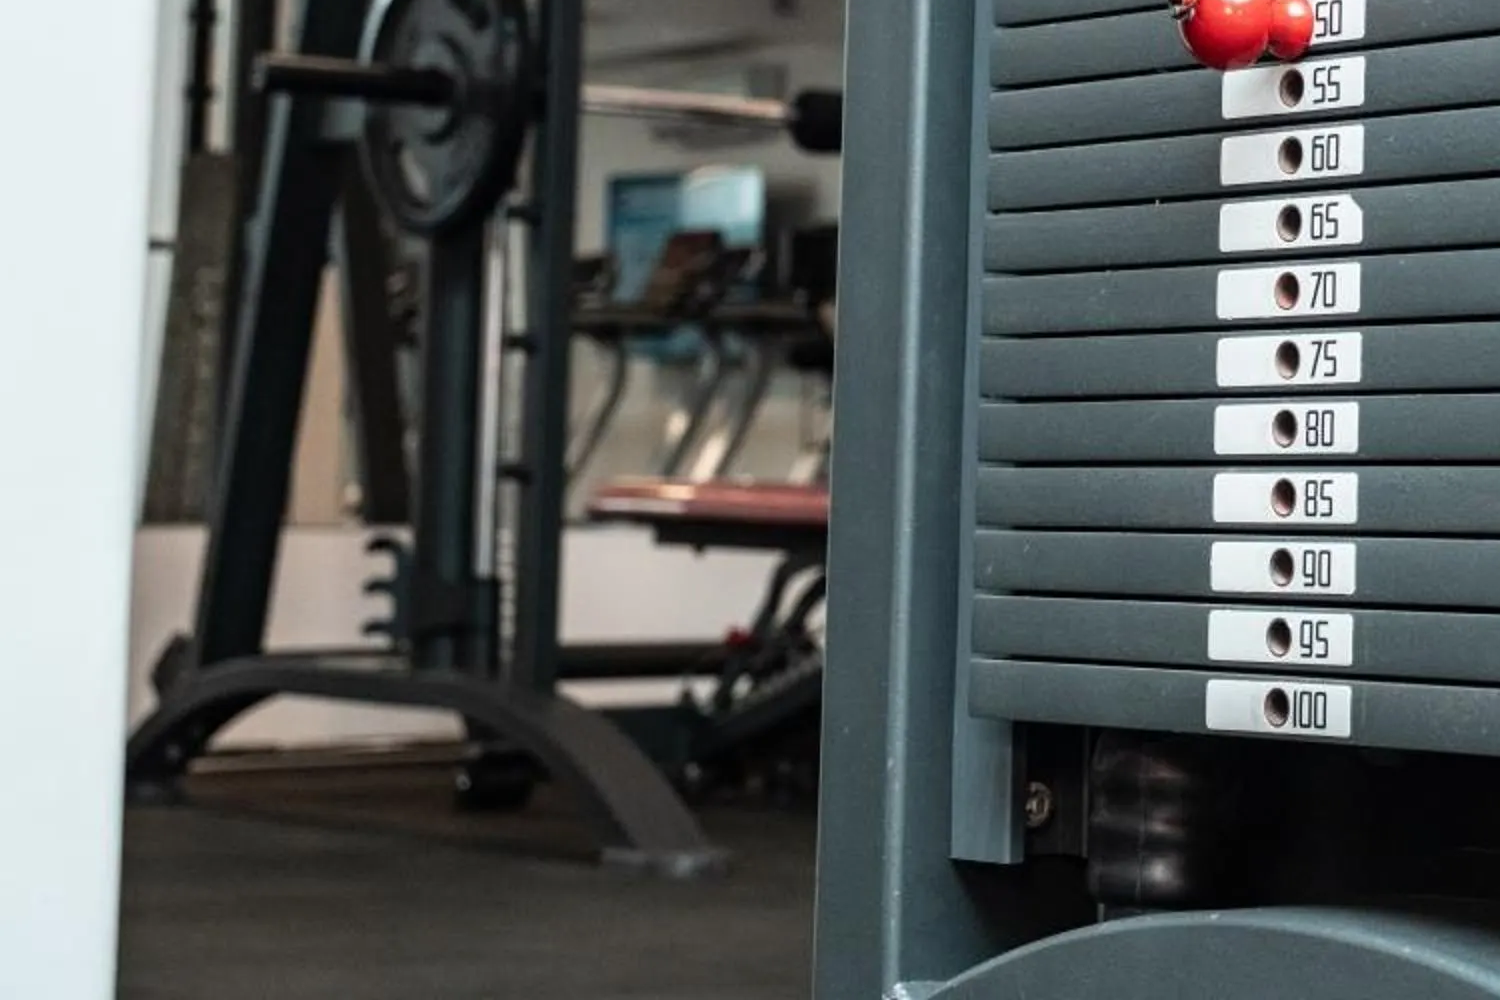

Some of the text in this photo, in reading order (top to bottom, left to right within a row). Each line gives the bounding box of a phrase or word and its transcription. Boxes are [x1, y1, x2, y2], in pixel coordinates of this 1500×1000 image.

[1316, 0, 1342, 38] 50
[1313, 66, 1340, 104] 55
[1312, 134, 1339, 171] 60
[1311, 202, 1338, 240] 65
[1311, 272, 1336, 308] 70
[1311, 340, 1336, 377] 75
[1306, 410, 1334, 446] 80
[1305, 480, 1332, 517] 85
[1303, 550, 1331, 587] 90
[1300, 620, 1328, 658] 95
[1293, 691, 1326, 729] 100
